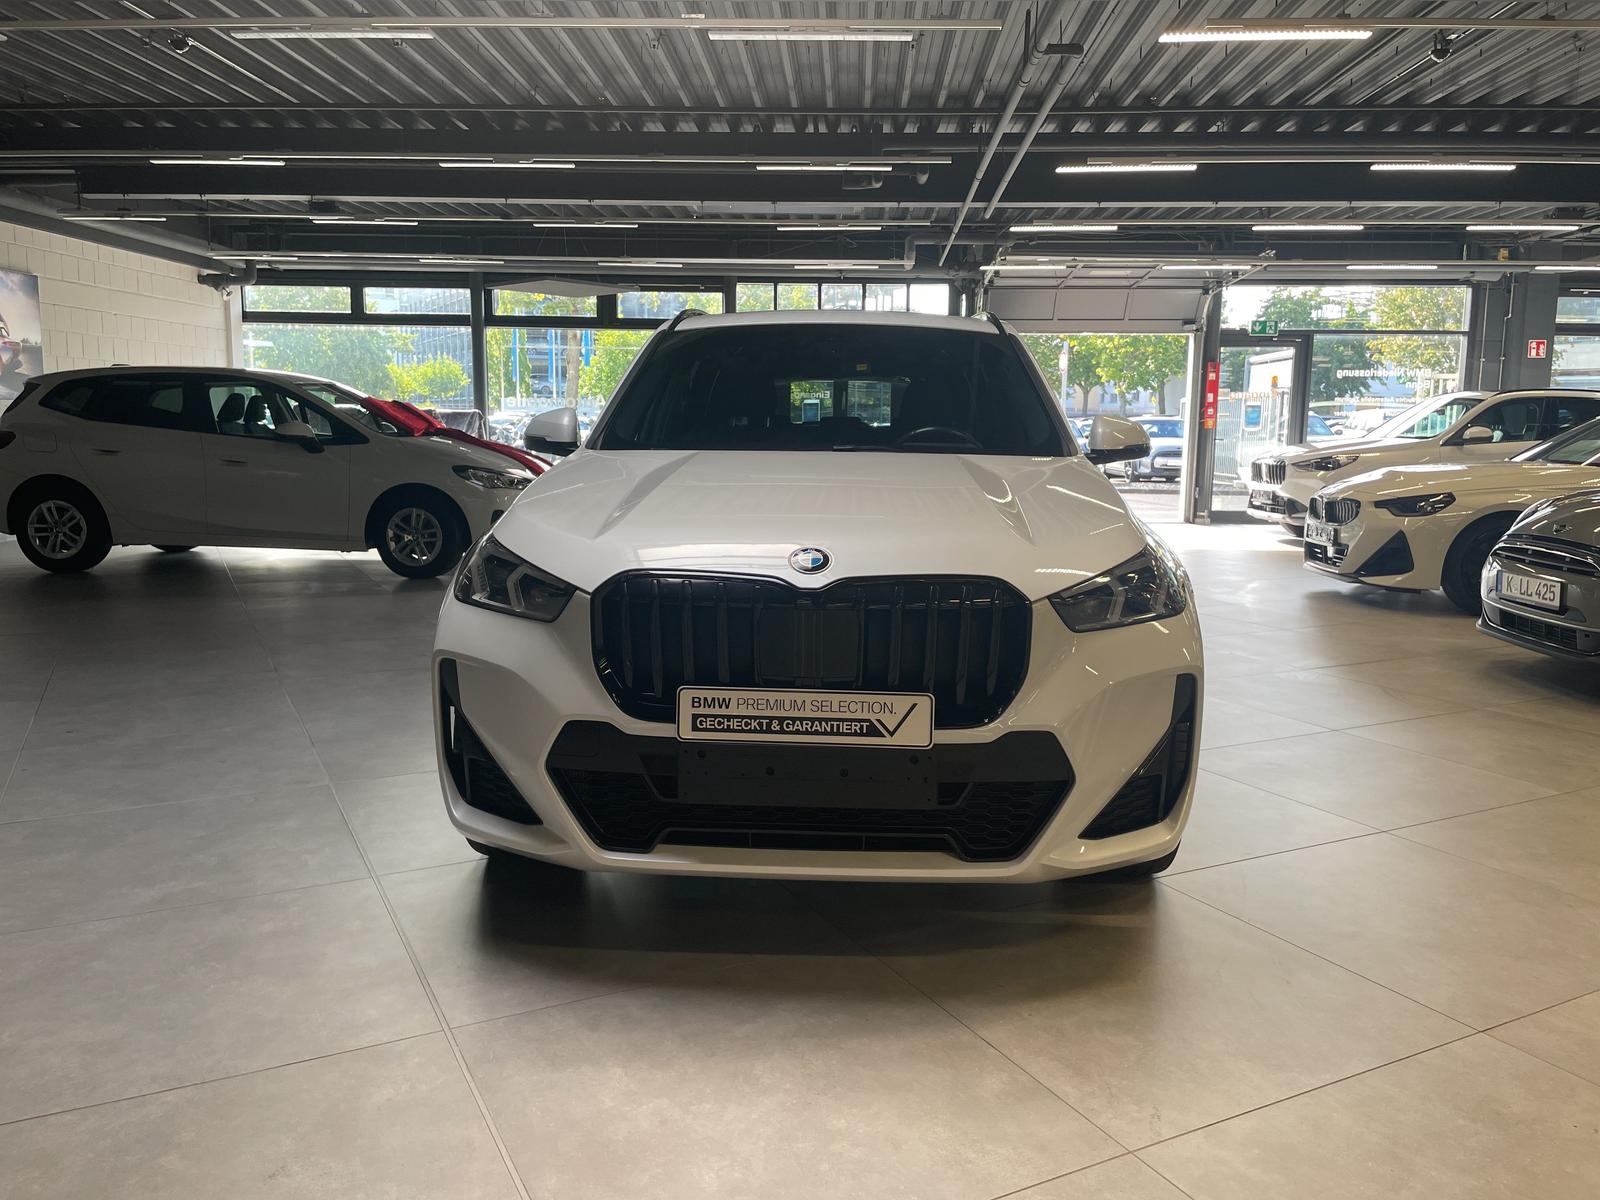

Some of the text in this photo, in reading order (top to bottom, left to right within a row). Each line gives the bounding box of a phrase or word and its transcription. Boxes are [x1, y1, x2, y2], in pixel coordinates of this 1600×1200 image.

[1506, 575, 1556, 602] K LL 425
[691, 696, 897, 715] BMW PREMIUM SELECTION.
[696, 717, 870, 734] GECHECKT & GARANTIERT
